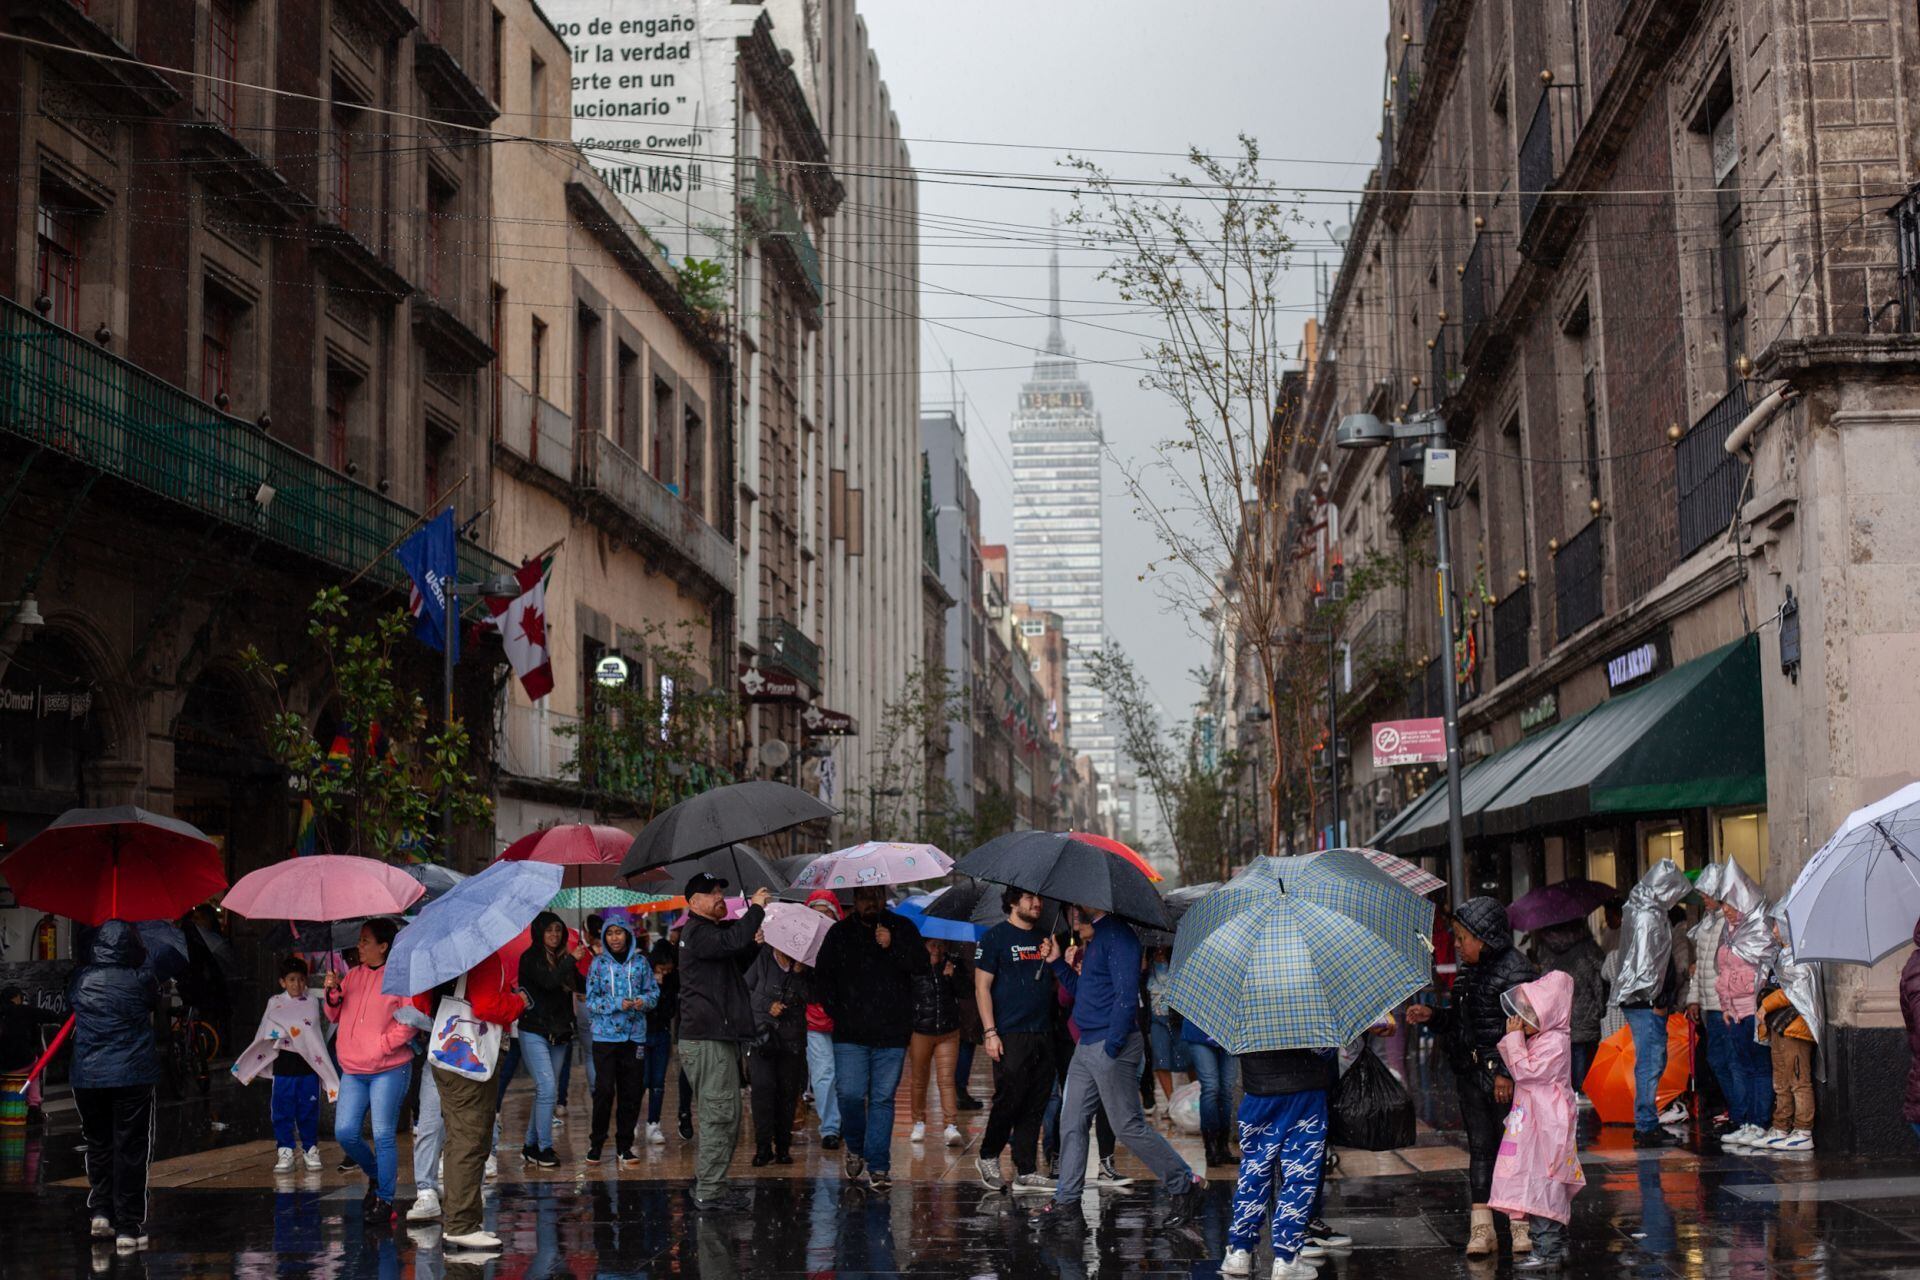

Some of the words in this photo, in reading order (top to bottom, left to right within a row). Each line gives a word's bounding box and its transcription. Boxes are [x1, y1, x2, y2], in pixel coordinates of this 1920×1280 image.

[588, 17, 612, 35] de
[619, 14, 695, 37] engaño
[596, 44, 613, 62] la
[620, 41, 690, 61] verdad
[618, 74, 643, 88] en
[651, 73, 675, 87] un
[574, 97, 670, 118] ucionario
[648, 165, 682, 193] MAS
[424, 570, 446, 610] Weste
[1011, 945, 1037, 953] Choose
